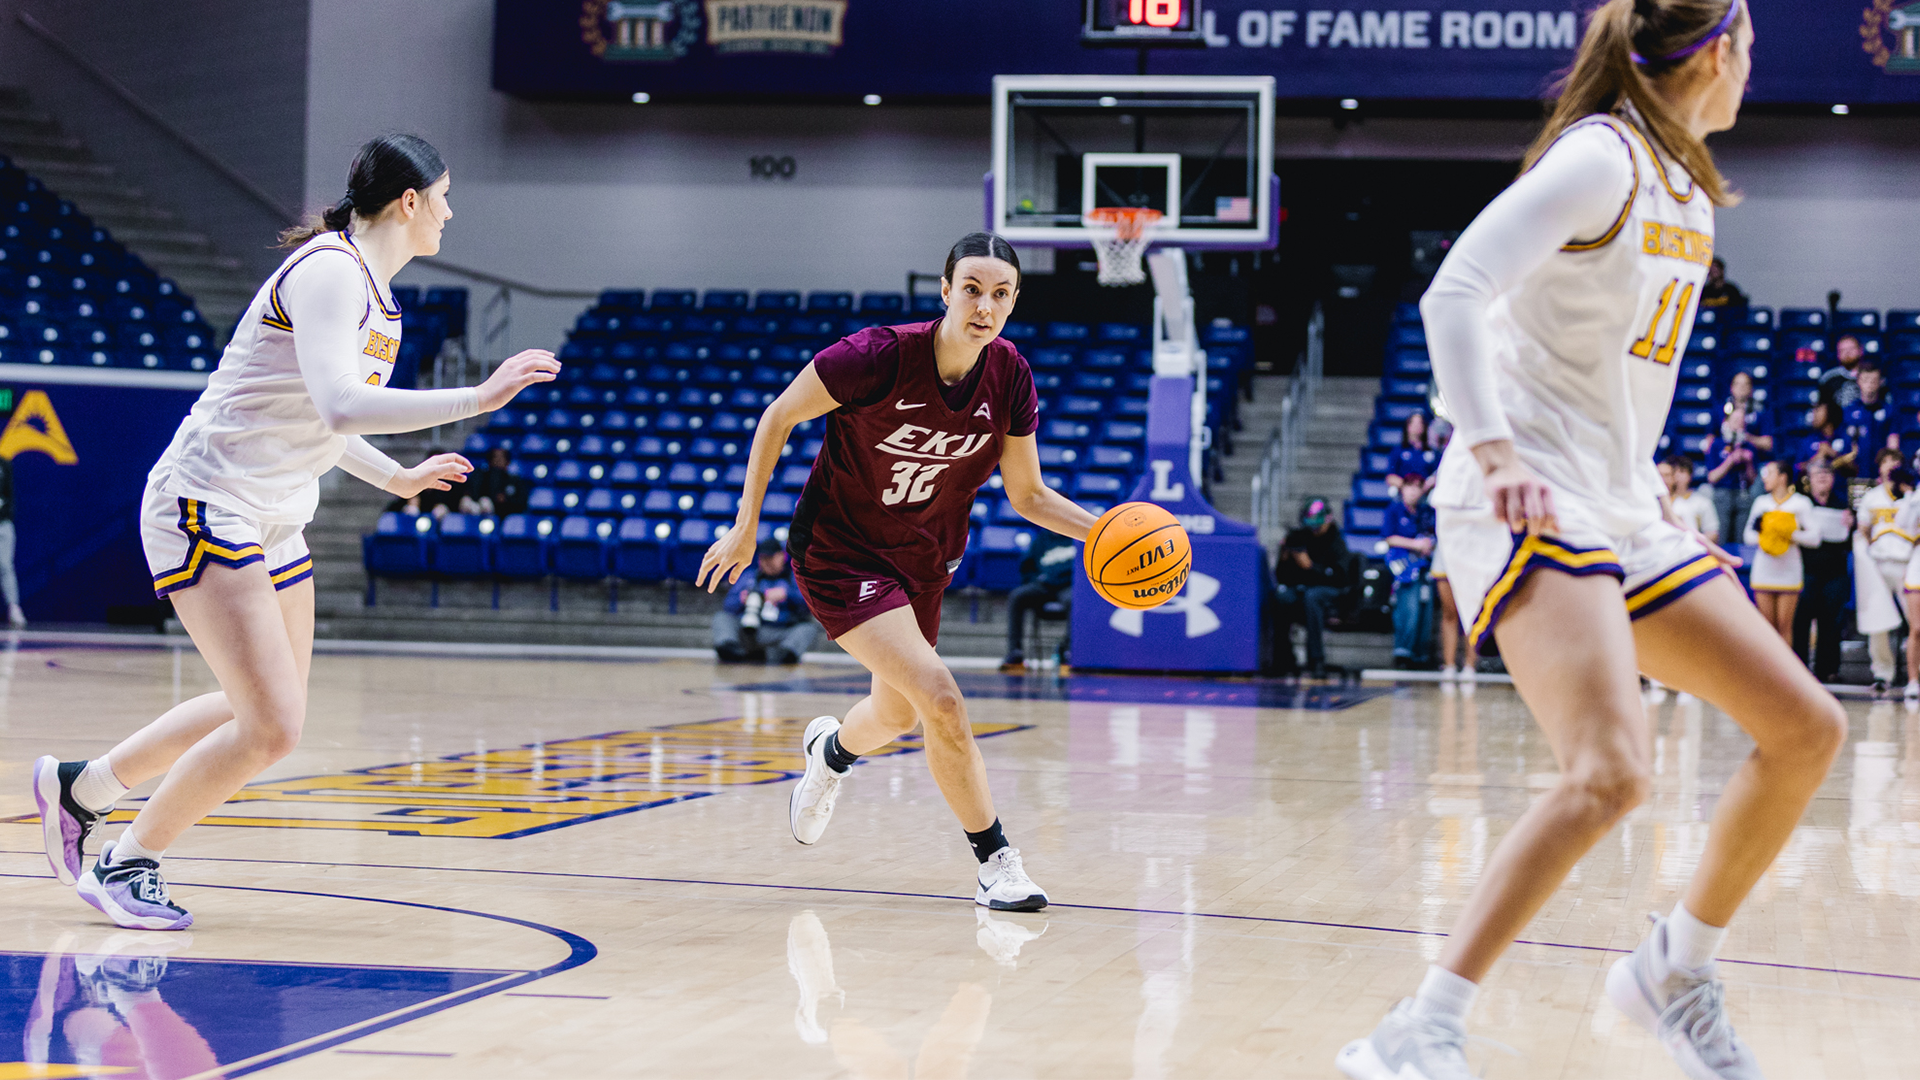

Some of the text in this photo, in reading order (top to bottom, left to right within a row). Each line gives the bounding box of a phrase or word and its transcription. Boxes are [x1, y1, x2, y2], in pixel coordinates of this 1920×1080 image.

[1237, 10, 1296, 48] OF
[1306, 10, 1431, 48] FAME
[1441, 10, 1577, 48] ROOM
[750, 156, 798, 180] 100
[1629, 277, 1694, 366] 11
[882, 423, 993, 458] EKU
[881, 460, 950, 506] 32
[1150, 459, 1185, 501] L
[1132, 562, 1190, 598] Wilson
